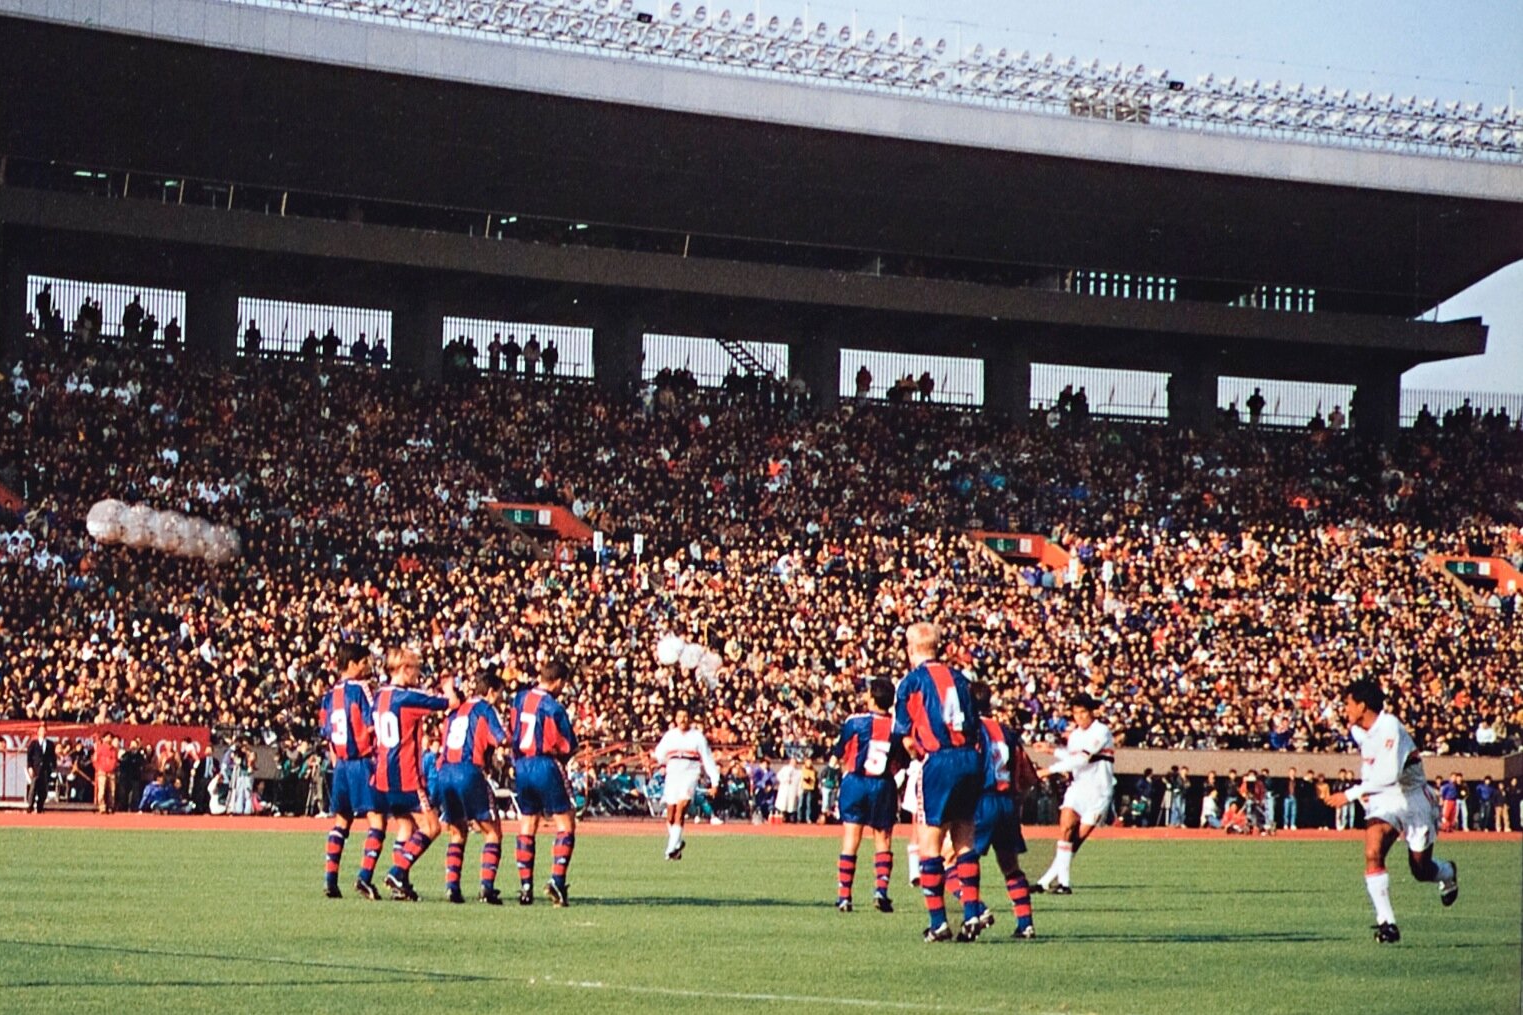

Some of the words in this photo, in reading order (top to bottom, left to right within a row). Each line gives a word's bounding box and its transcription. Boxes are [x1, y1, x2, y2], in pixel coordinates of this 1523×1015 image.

[330, 708, 348, 745] 3
[943, 686, 965, 731] 4
[372, 710, 400, 748] 10
[446, 715, 469, 750] 8
[519, 712, 536, 749] 7
[864, 740, 891, 775] 5
[991, 741, 1010, 782] 2
